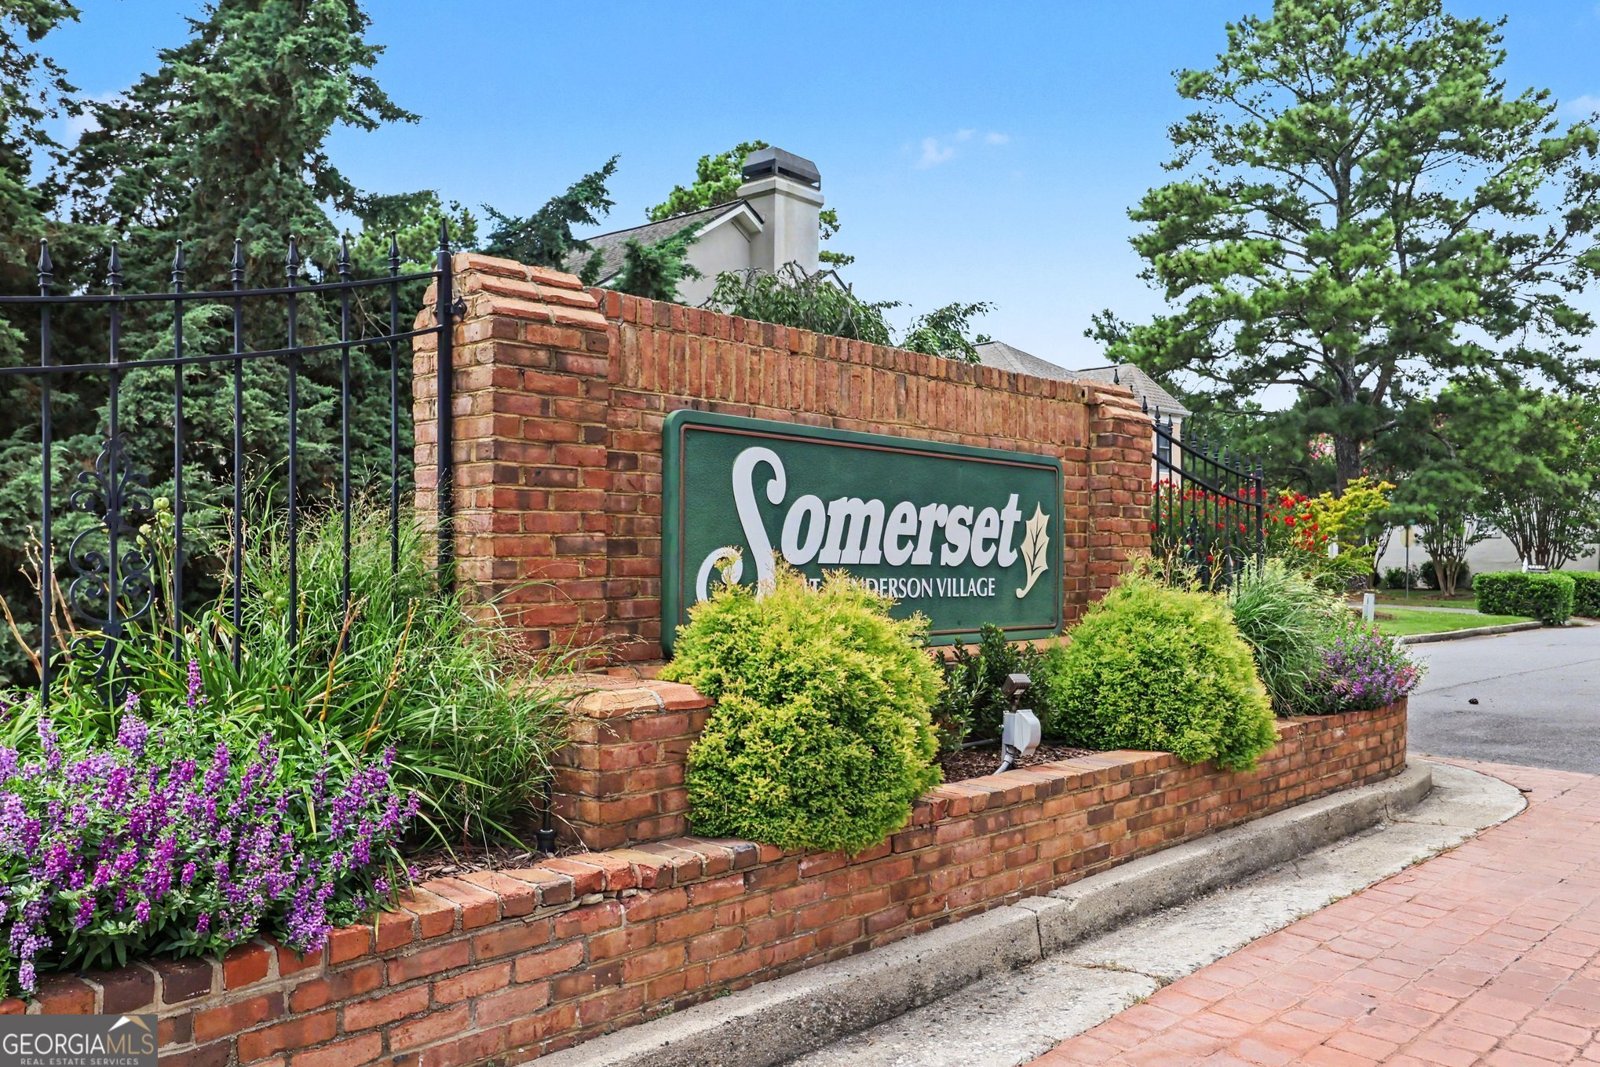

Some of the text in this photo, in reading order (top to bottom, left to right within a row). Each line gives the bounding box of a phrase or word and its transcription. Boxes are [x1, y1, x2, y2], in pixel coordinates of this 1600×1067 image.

[695, 446, 1022, 602] Somerset
[834, 577, 933, 599] DERSON
[936, 577, 996, 598] VILLAGE
